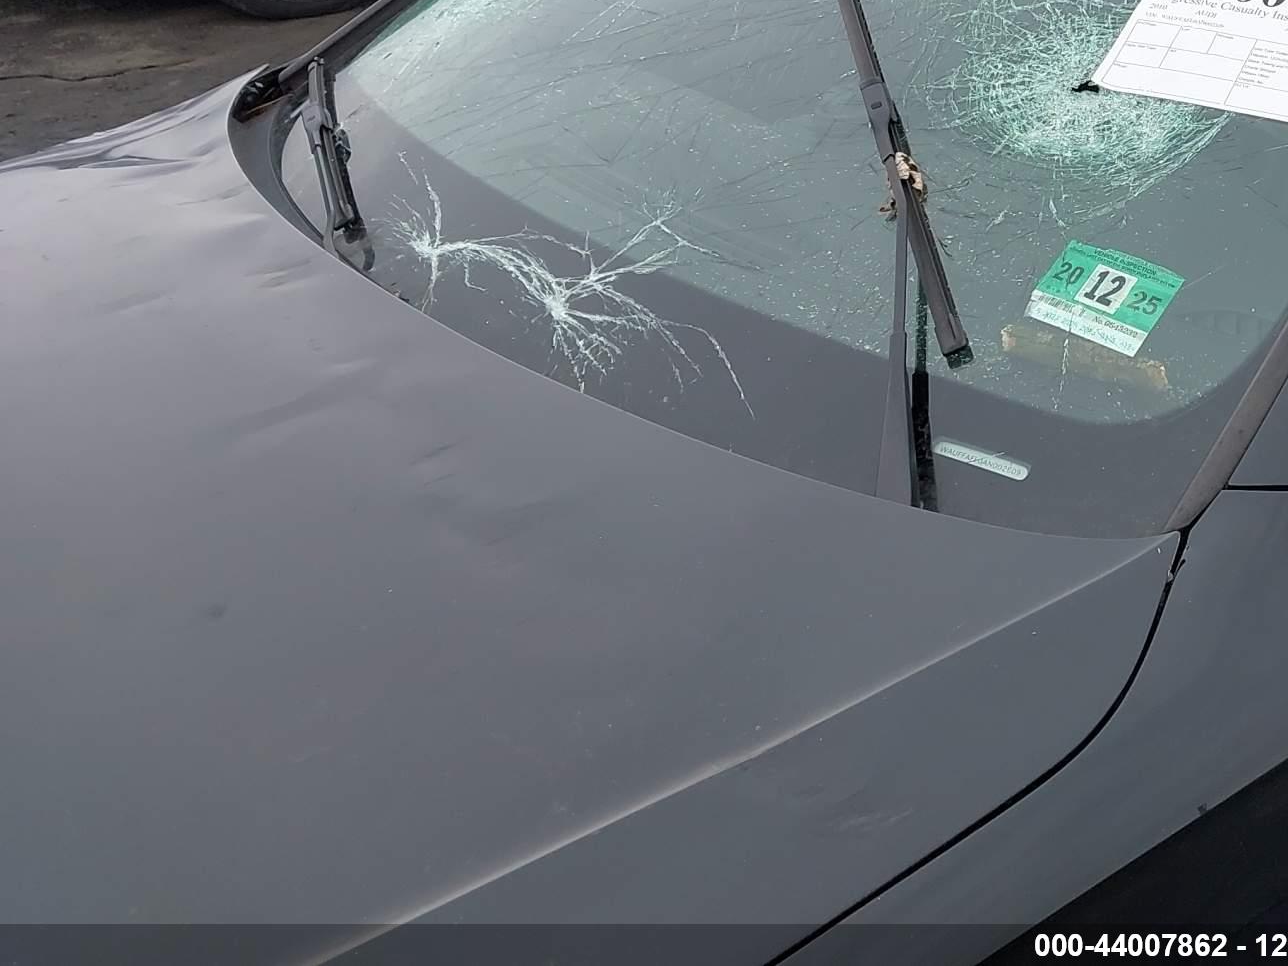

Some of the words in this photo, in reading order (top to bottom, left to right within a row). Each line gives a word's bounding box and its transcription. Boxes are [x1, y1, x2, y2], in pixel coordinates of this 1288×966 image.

[1195, 8, 1219, 20] AUDI
[1220, 0, 1270, 19] Casualty
[1052, 262, 1085, 285] 20
[1084, 270, 1127, 307] 12
[1126, 290, 1163, 316] 25
